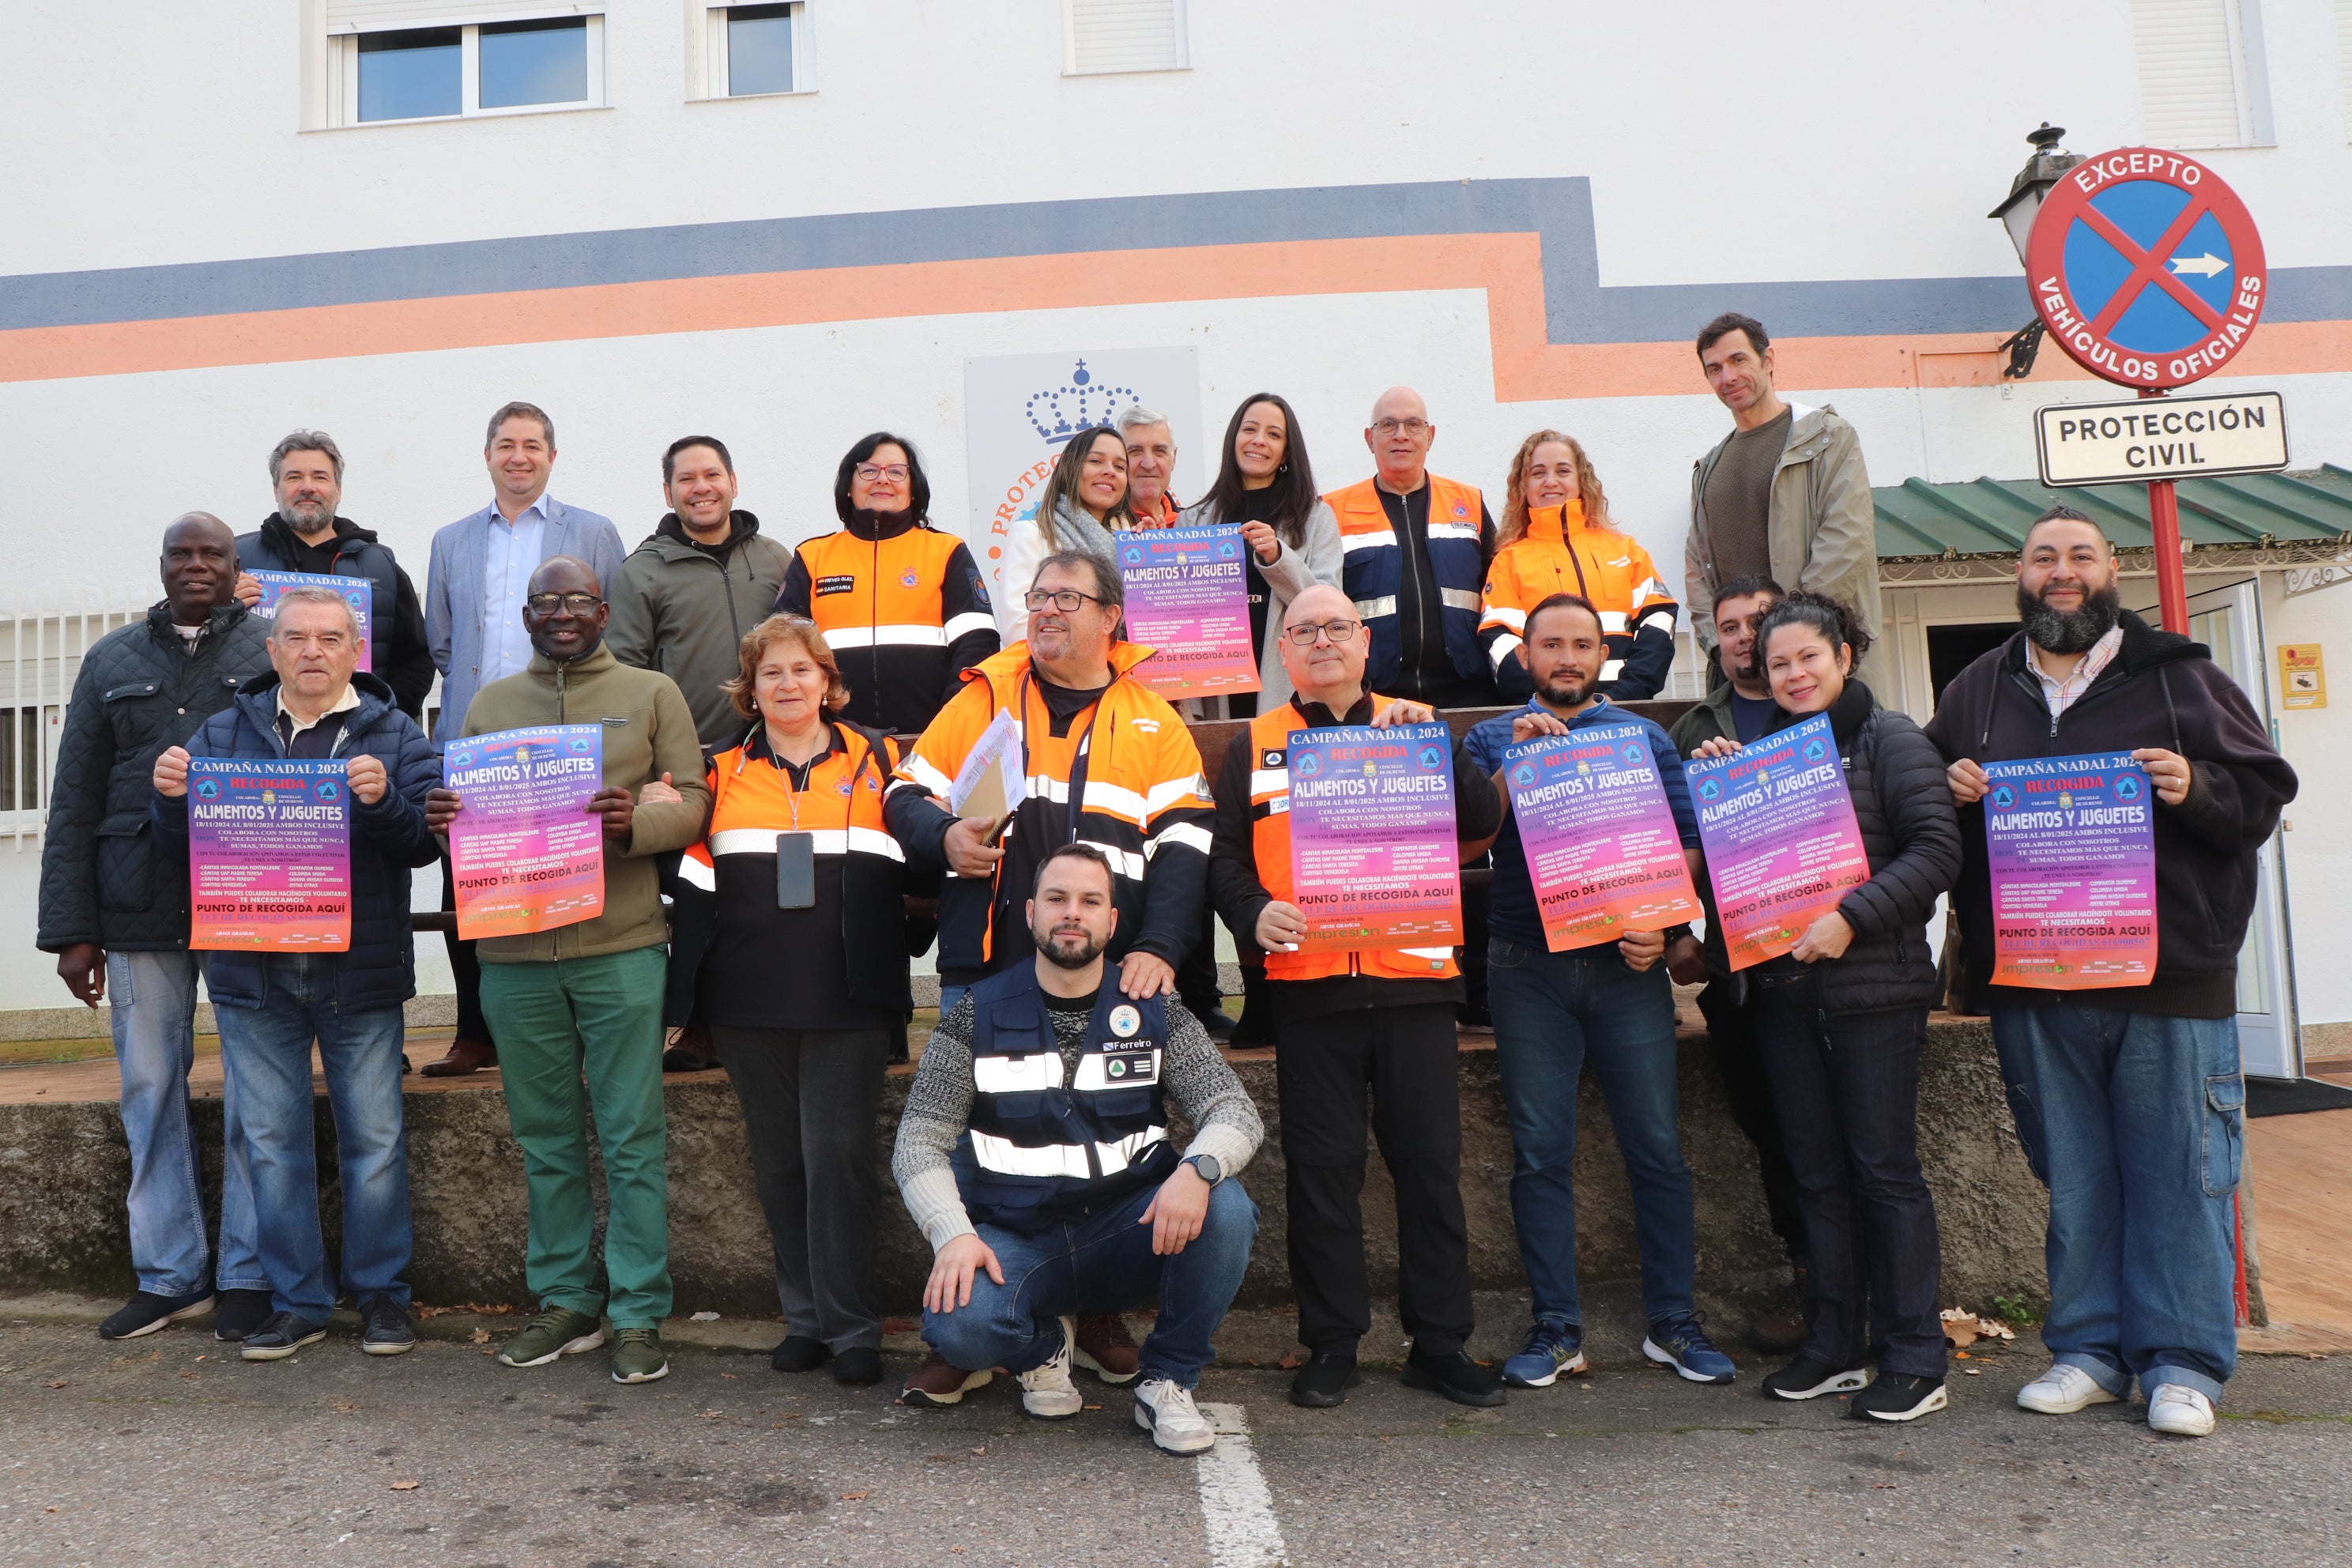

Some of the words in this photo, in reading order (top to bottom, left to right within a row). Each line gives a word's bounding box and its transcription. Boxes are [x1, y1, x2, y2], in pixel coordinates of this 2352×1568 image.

[2074, 153, 2201, 193] EXCEPTO
[2039, 276, 2158, 381] VEHÍCULOS
[2169, 275, 2261, 379] OFICIALES
[2060, 404, 2265, 442] PROTECCIÓN
[2125, 443, 2205, 468] CIVIL
[1118, 530, 1174, 541] CAMPAÑA
[1175, 529, 1215, 539] NADAL
[1216, 526, 1238, 537] 2024
[307, 577, 344, 586] NADAL
[1124, 566, 1179, 582] ALIMENTOS
[1181, 566, 1189, 579] Y
[1191, 563, 1240, 578] JUGUETES
[1180, 652, 1224, 661] RECOGIDA
[1227, 649, 1249, 658] AQUÍ
[449, 733, 515, 750] CAMPAÑA
[1291, 729, 1363, 744] CAMPAÑA
[1365, 729, 1415, 741] NADAL
[1417, 726, 1445, 739] 2024
[1506, 737, 1571, 759] CAMPAÑA
[1572, 729, 1616, 744] NADAL
[1618, 724, 1642, 737] 2024
[1755, 730, 1799, 754] NADAL
[1800, 718, 1826, 737] 2024
[1330, 745, 1407, 761] RECOGIDA
[1543, 745, 1613, 767] RECOGIDA
[191, 761, 262, 773] CAMPAÑA
[265, 763, 314, 774] NADAL
[316, 764, 345, 774] 2024
[450, 765, 518, 787] ALIMENTOS
[522, 763, 531, 779] Y
[534, 758, 594, 778] JUGUETES
[1726, 748, 1793, 781] RECOGIDA
[1984, 761, 2056, 778] CAMPAÑA
[2057, 758, 2110, 773] NADAL
[230, 777, 307, 790] RECOGIDA
[453, 786, 485, 794] 8/11/2024
[531, 779, 556, 788] AMBOS
[558, 774, 597, 784] INCLUSIVE
[1294, 778, 1366, 798] ALIMENTOS
[1369, 778, 1378, 794] Y
[1381, 775, 1446, 794] JUGUETES
[1517, 778, 1584, 808] ALIMENTOS
[1585, 776, 1593, 790] Y
[1598, 767, 1654, 789] JUGUETES
[1702, 788, 1763, 824] ALIMENTOS
[1764, 784, 1772, 799] Y
[1776, 763, 1836, 797] JUGUETES
[2023, 776, 2102, 793] RECOGIDA
[1407, 793, 1449, 802] INCLUSIVE
[1565, 793, 1595, 805] 8/01/2025
[1596, 789, 1621, 798] AMBOS
[1622, 784, 1660, 794] INCLUSIVE
[1737, 813, 1746, 822] AL
[1746, 802, 1773, 817] 8/01/2025
[1774, 793, 1800, 807] AMBOS
[1800, 780, 1842, 797] INCLUSIVE
[194, 805, 266, 820] ALIMENTOS
[268, 806, 277, 820] Y
[280, 806, 343, 821] JUGUETES
[1992, 811, 2063, 831] ALIMENTOS
[2065, 810, 2075, 827] Y
[2079, 806, 2145, 827] JUGUETES
[2104, 826, 2148, 835] INCLUSIVE
[459, 878, 498, 888] PUNTO
[503, 876, 515, 884] DE
[520, 868, 572, 883] RECOGIDA
[575, 861, 598, 873] AQUÍ
[1299, 894, 1339, 904] PUNTO
[1343, 893, 1356, 903] DE
[1360, 890, 1419, 901] RECOGIDA
[1423, 885, 1453, 899] AQUÍ
[1541, 889, 1579, 906] PUNTO
[1582, 884, 1596, 895] DE
[1598, 873, 1653, 891] RECOGIDA
[1657, 865, 1683, 879] AQUÍ
[1723, 903, 1756, 921] PUNTO
[1759, 897, 1773, 908] DE
[1775, 881, 1832, 903] RECOGIDA
[1836, 870, 1864, 886] AQUÍ
[317, 903, 345, 913] AQUÍ
[2079, 909, 2113, 918] HACIÉNDOTE
[2000, 929, 2037, 938] PUNTO
[2041, 928, 2053, 937] DE
[2057, 927, 2116, 937] RECOGIDA
[2120, 924, 2150, 936] AQUÍ
[1114, 1039, 1152, 1050] Ferreiro
